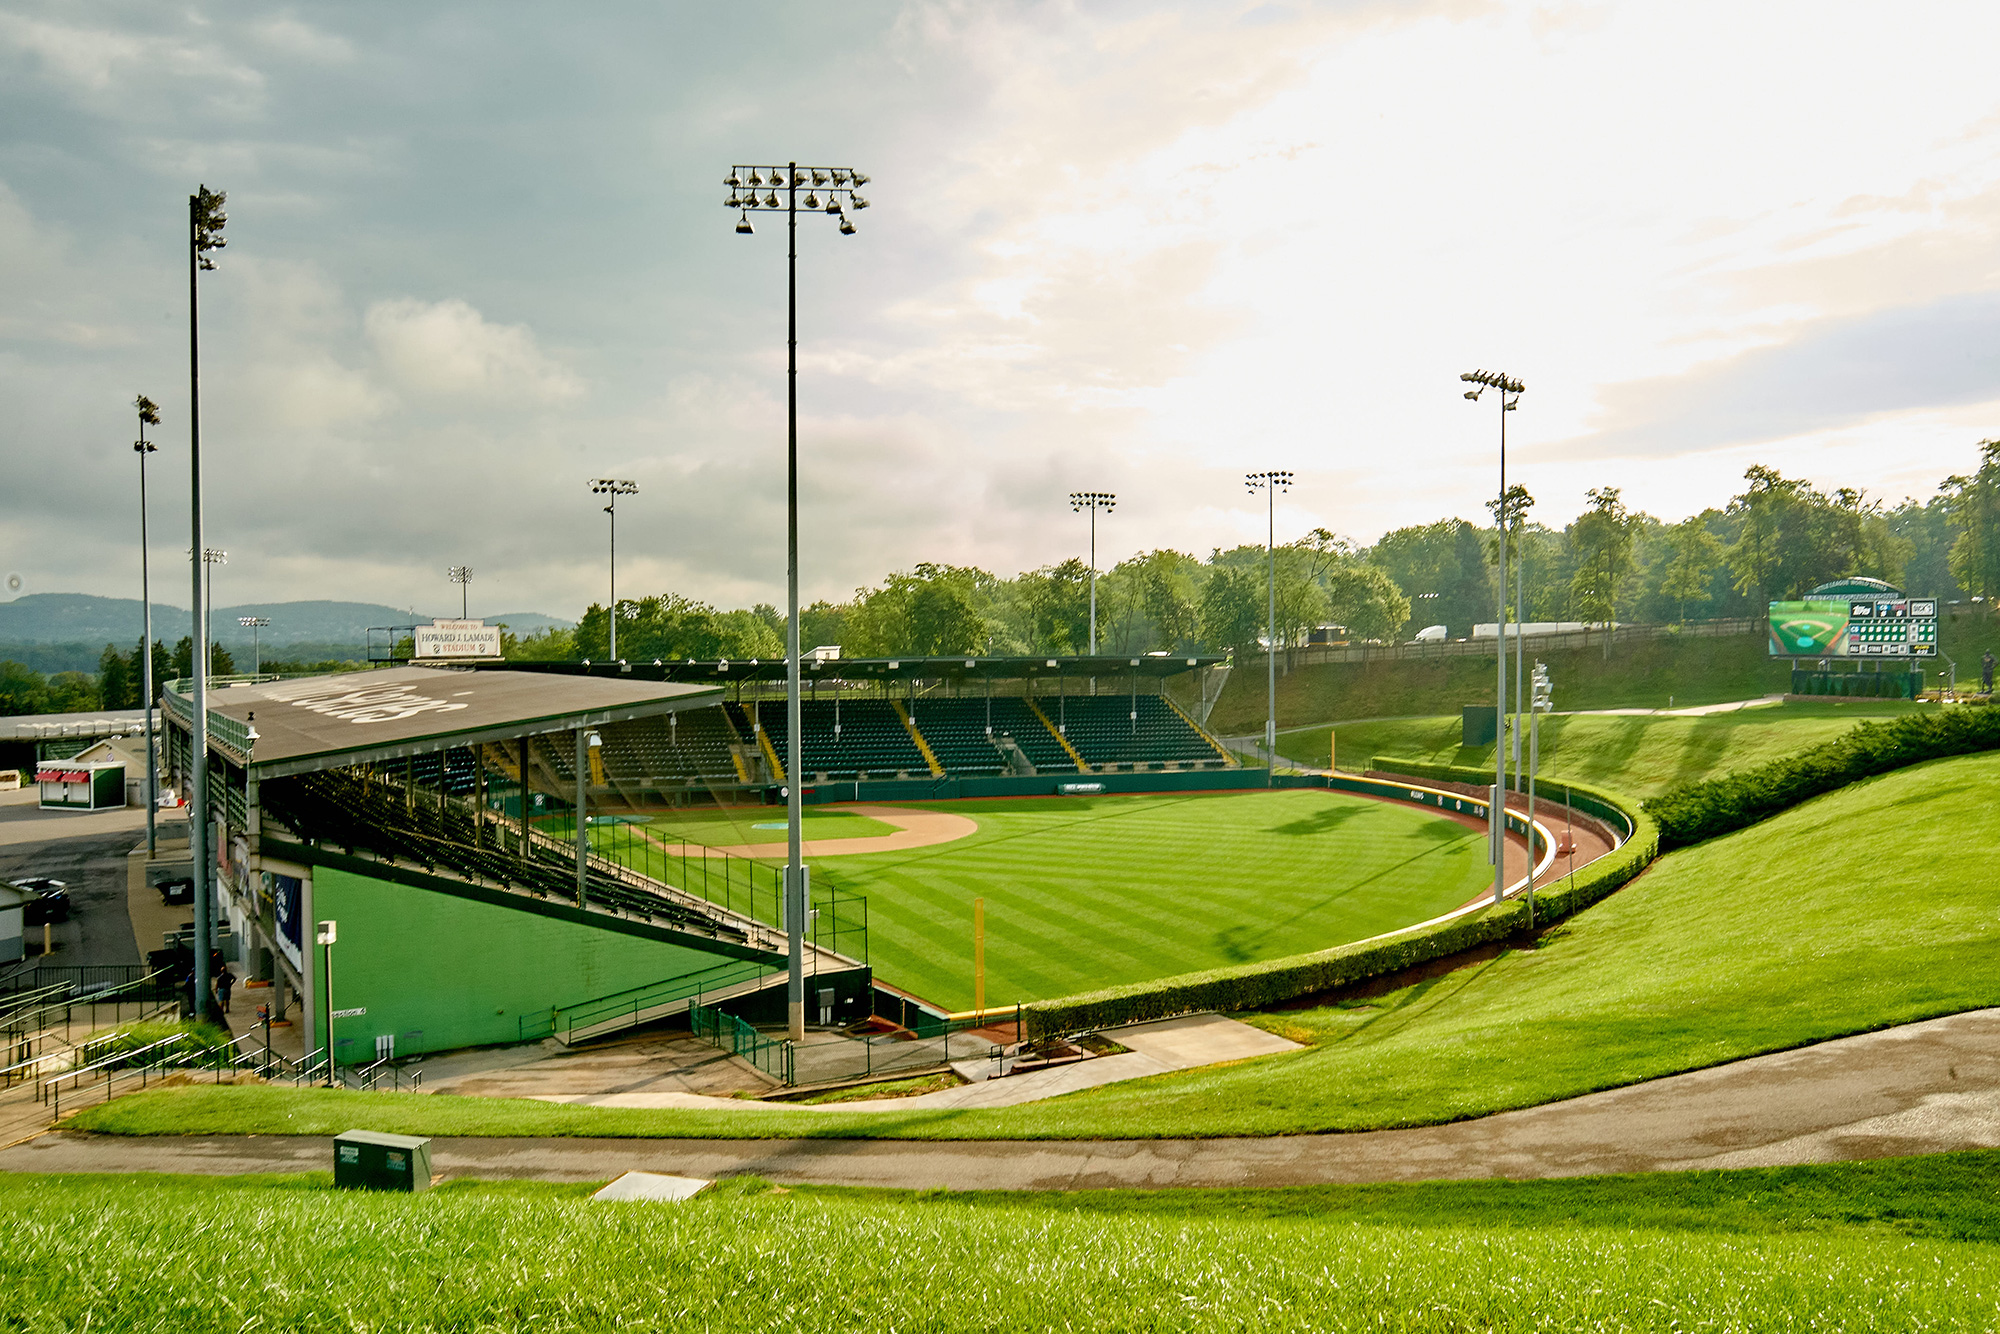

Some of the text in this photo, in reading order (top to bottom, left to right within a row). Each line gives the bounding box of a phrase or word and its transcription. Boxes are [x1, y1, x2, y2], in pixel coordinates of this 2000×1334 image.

[421, 633, 455, 642] HOWARD
[464, 633, 496, 642] LAMADE
[443, 644, 476, 652] STADIUM
